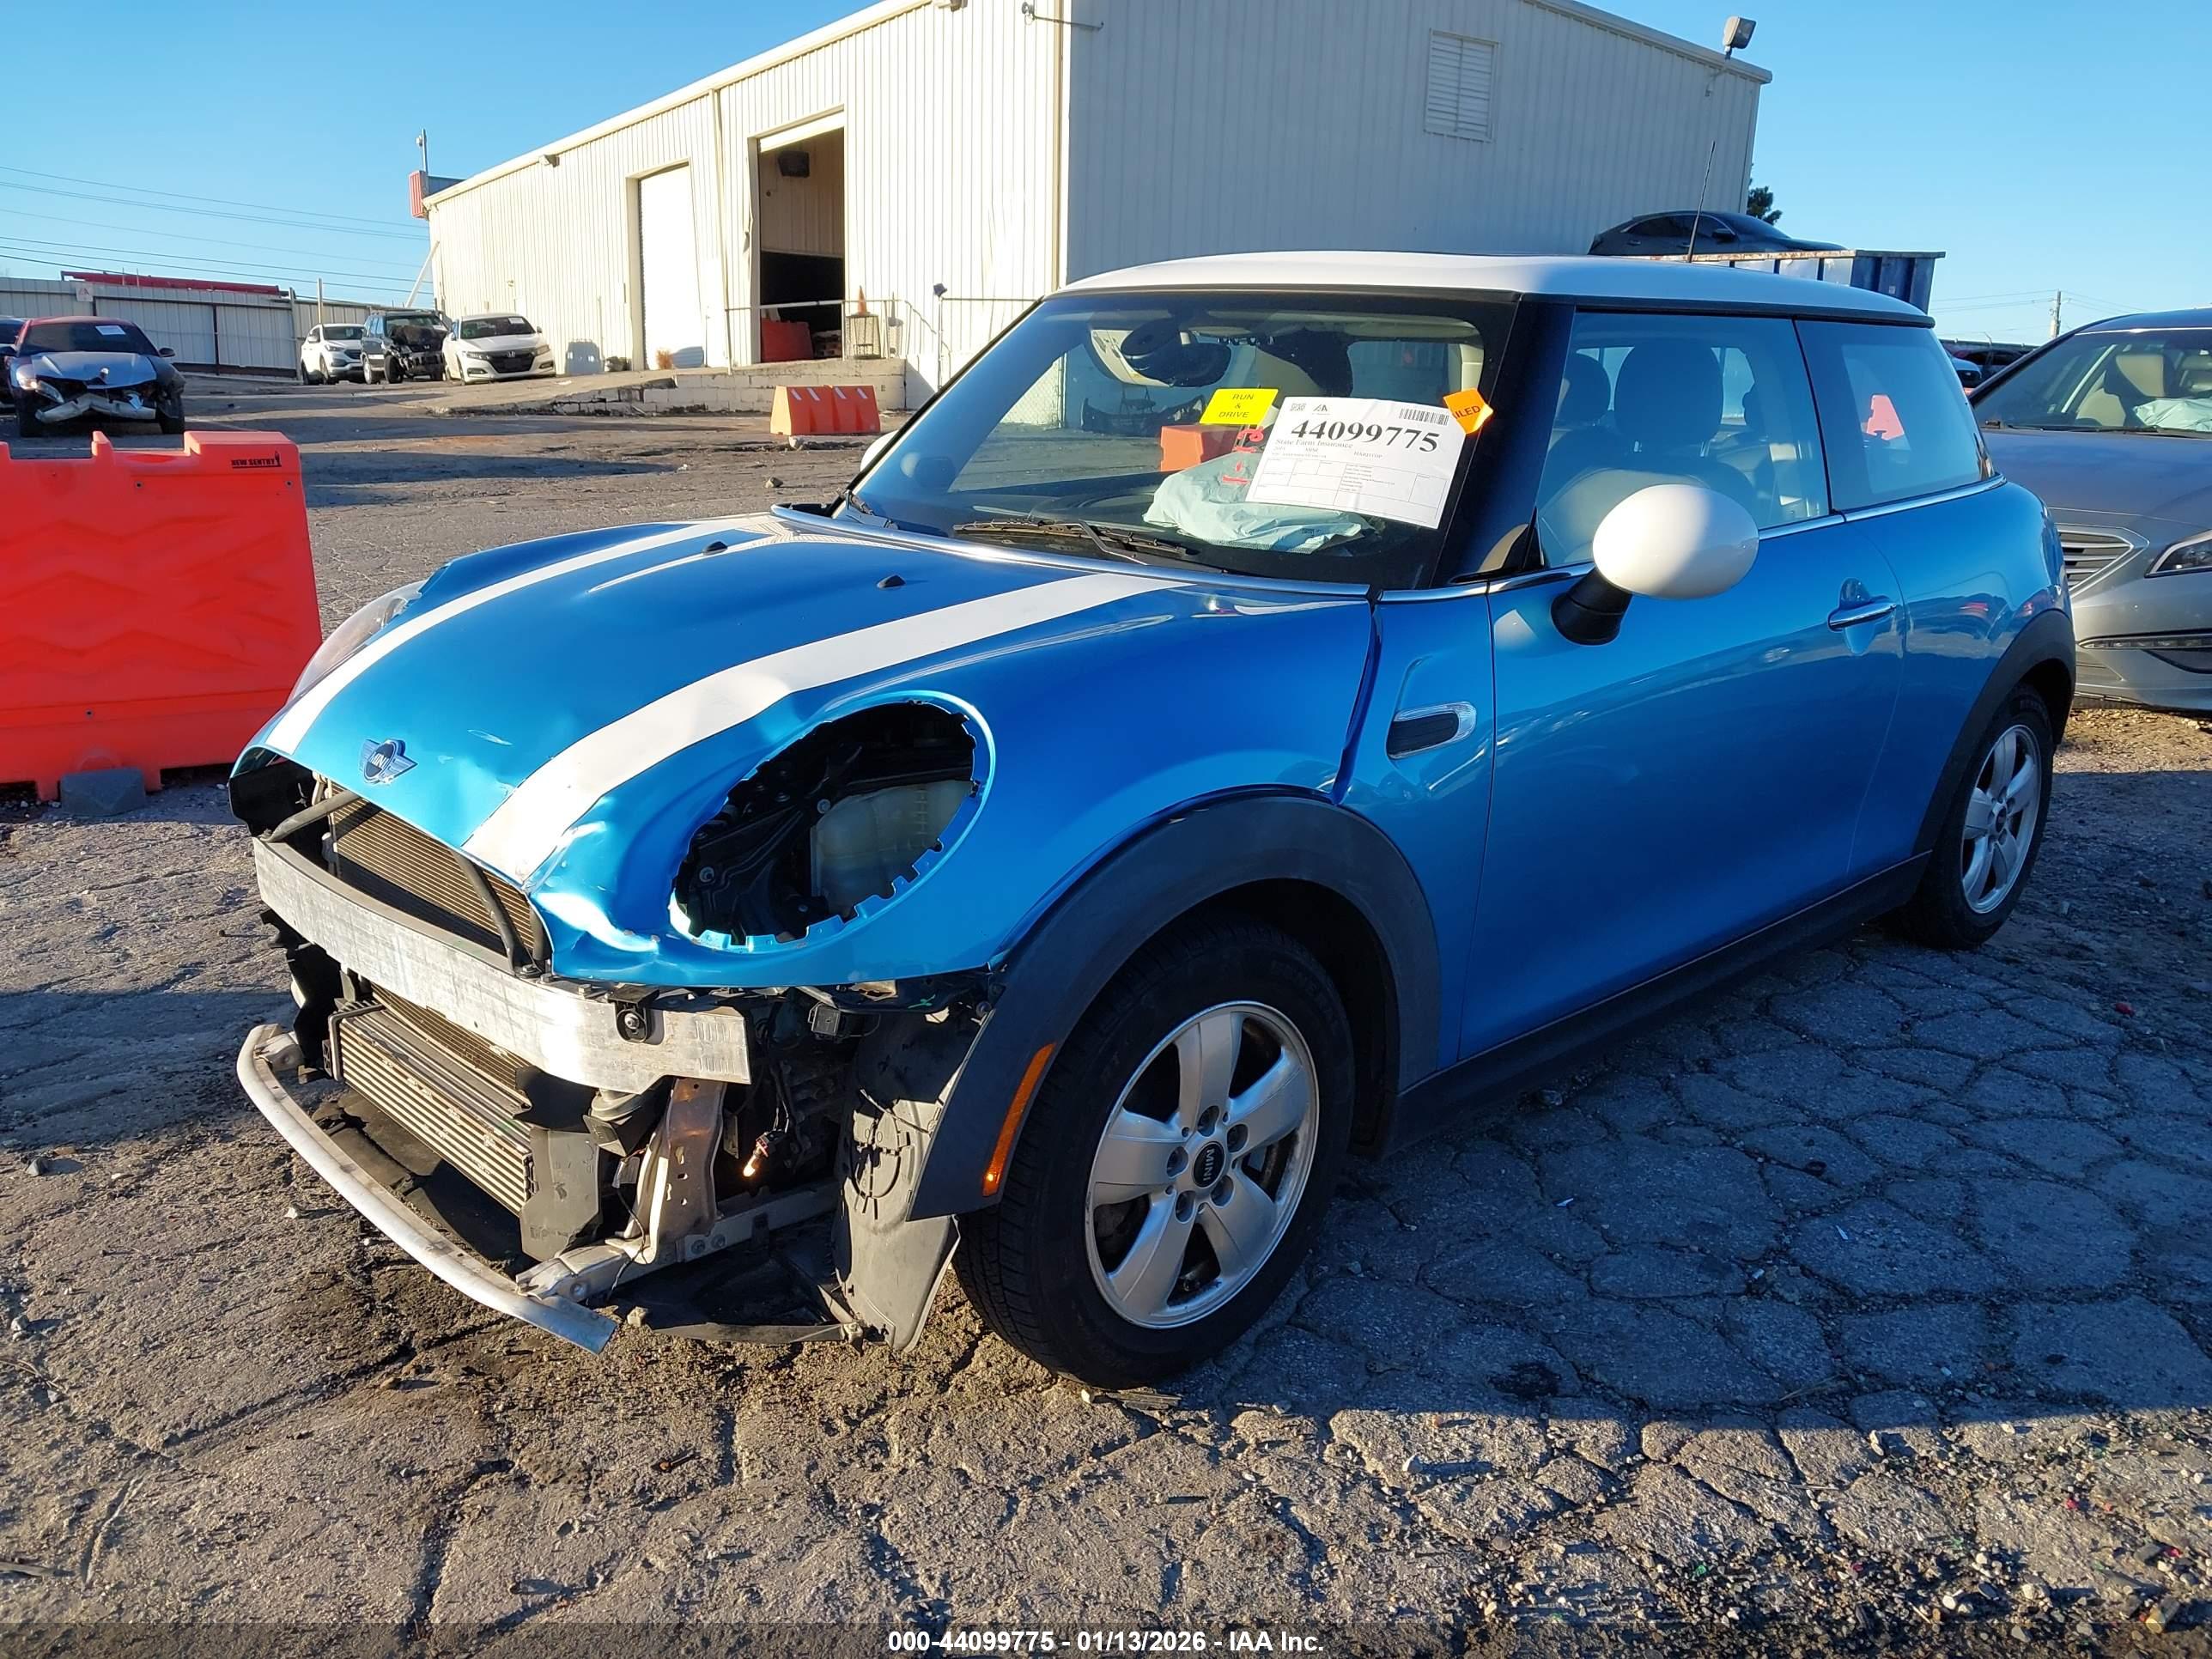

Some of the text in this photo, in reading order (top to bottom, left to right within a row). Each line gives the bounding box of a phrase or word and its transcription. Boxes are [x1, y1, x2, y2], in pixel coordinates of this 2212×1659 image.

[1291, 420, 1440, 453] 44099775
[1317, 440, 1353, 448] Insurance
[369, 752, 389, 769] MINI
[1203, 1148, 1215, 1181] MINI
